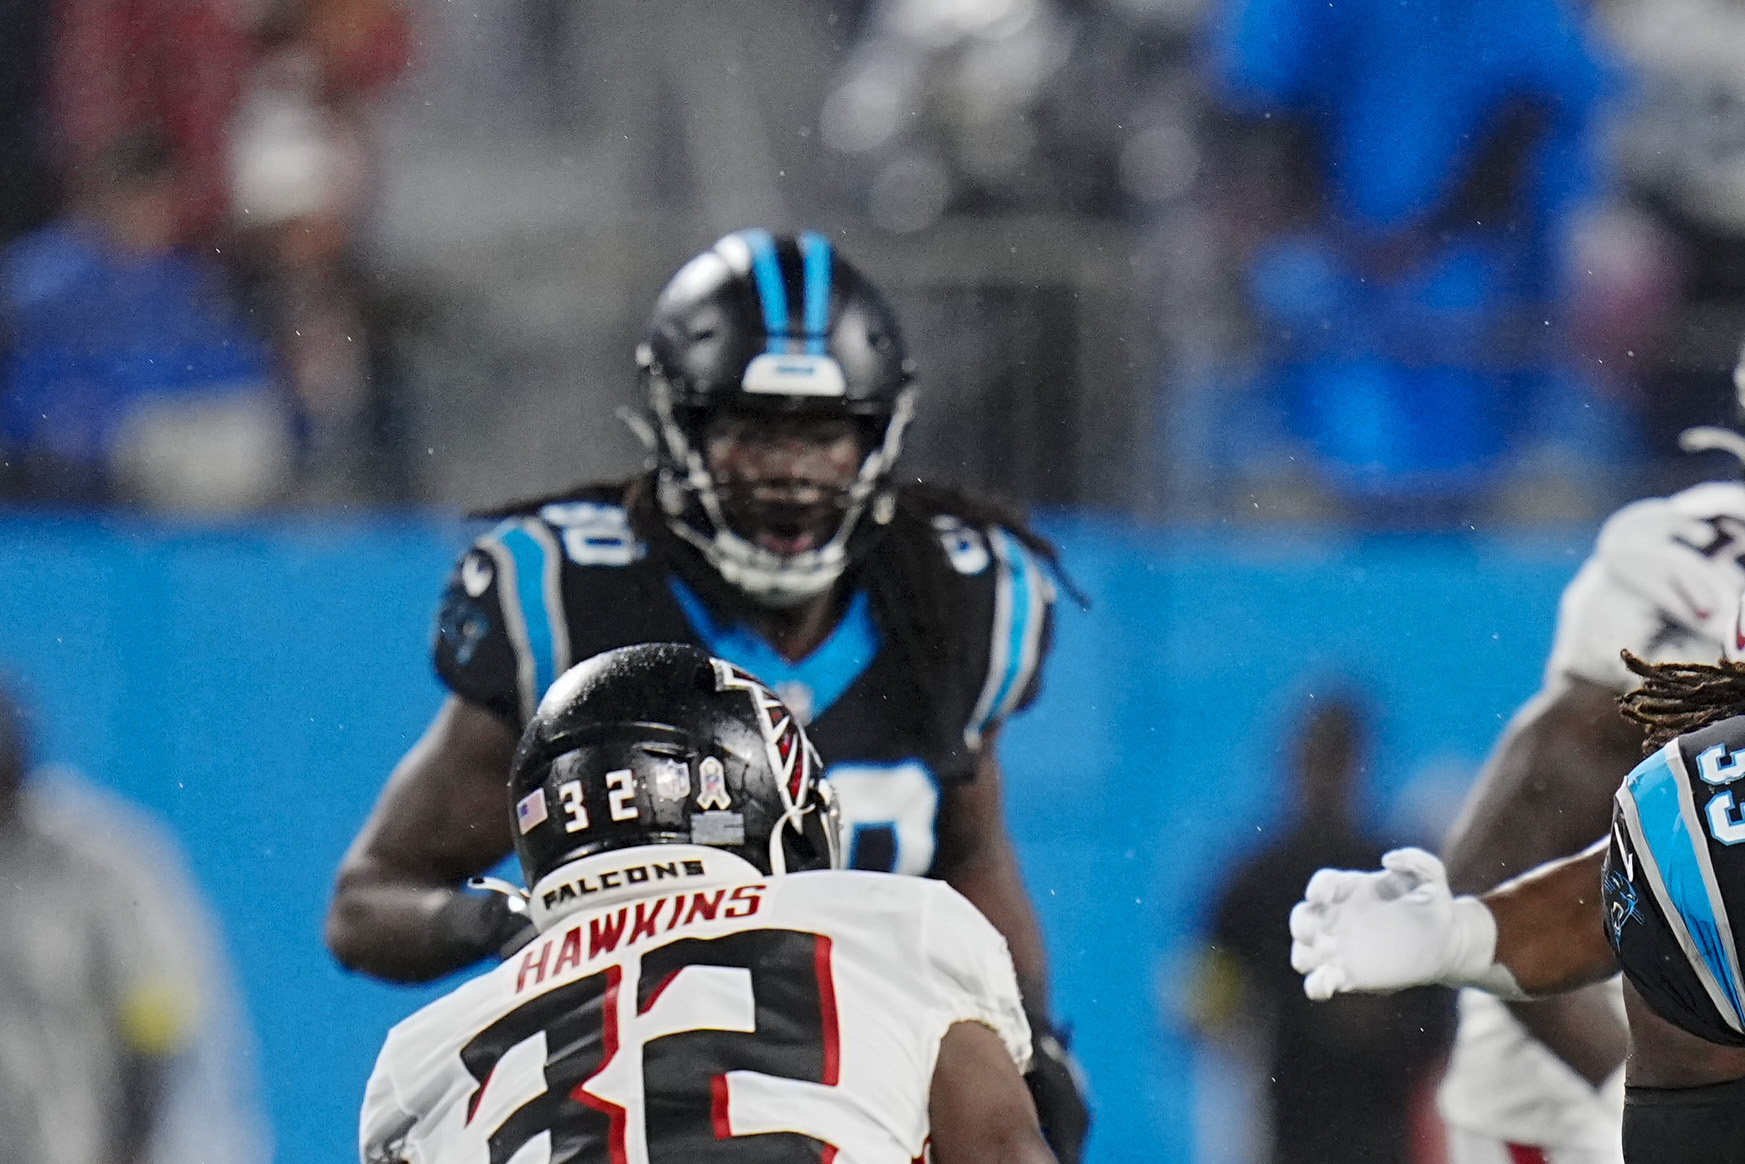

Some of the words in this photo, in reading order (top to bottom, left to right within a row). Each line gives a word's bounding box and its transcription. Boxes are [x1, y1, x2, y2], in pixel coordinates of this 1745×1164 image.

[558, 767, 640, 834] 32
[541, 859, 706, 911] FALCONS
[515, 884, 767, 995] HAWKINS
